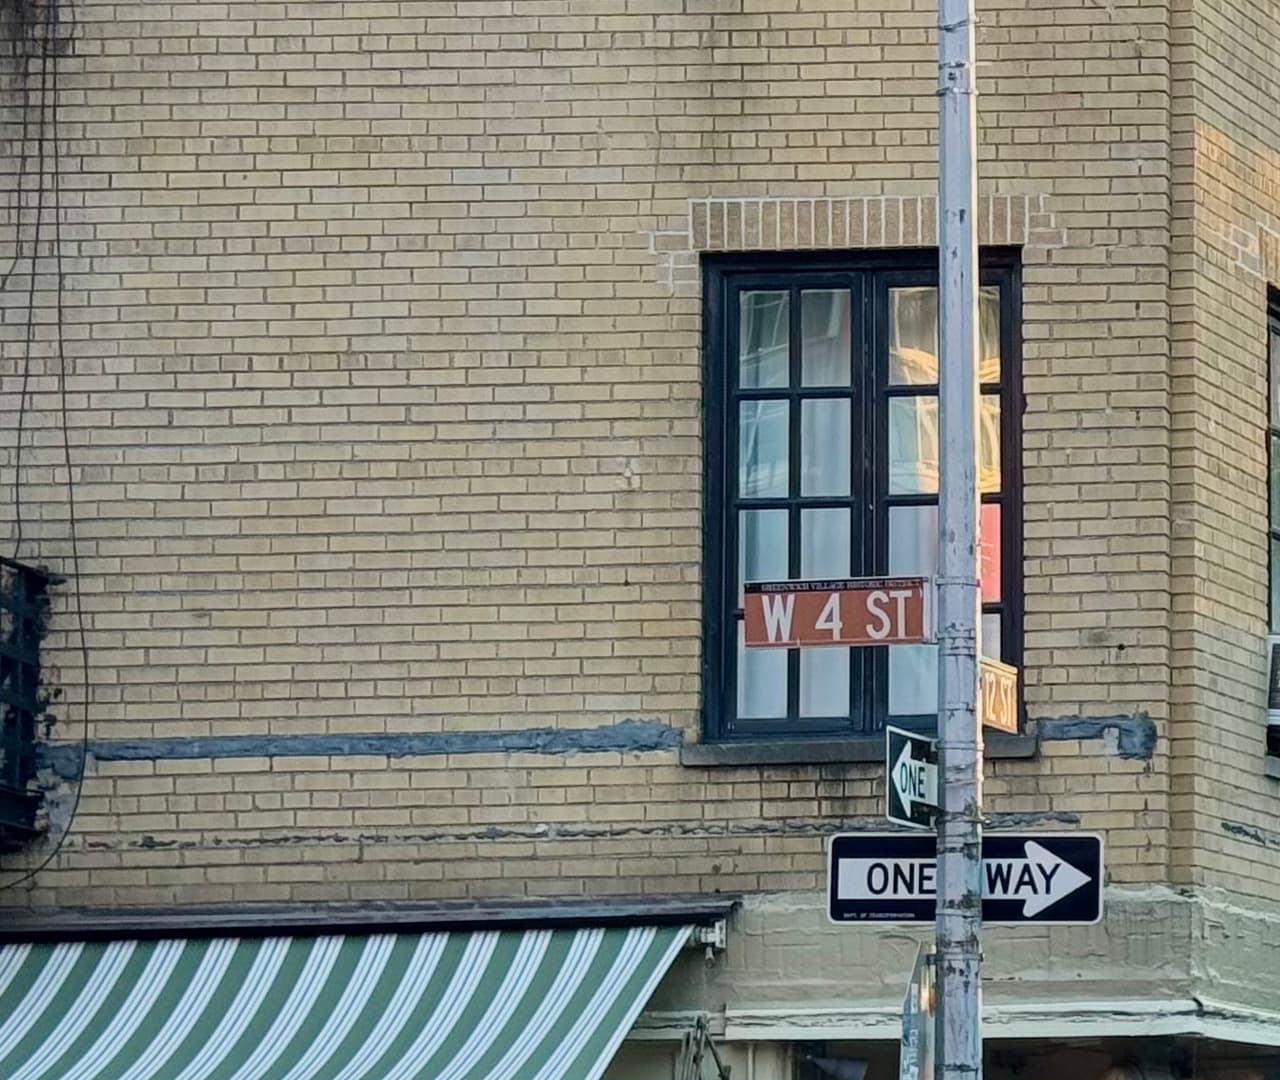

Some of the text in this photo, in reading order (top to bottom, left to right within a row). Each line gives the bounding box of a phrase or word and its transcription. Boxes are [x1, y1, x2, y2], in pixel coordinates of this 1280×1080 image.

[761, 590, 913, 644] W 4 ST
[984, 671, 1013, 727] 12 ST
[900, 762, 926, 799] ONE
[867, 863, 1061, 895] ONE WAY
